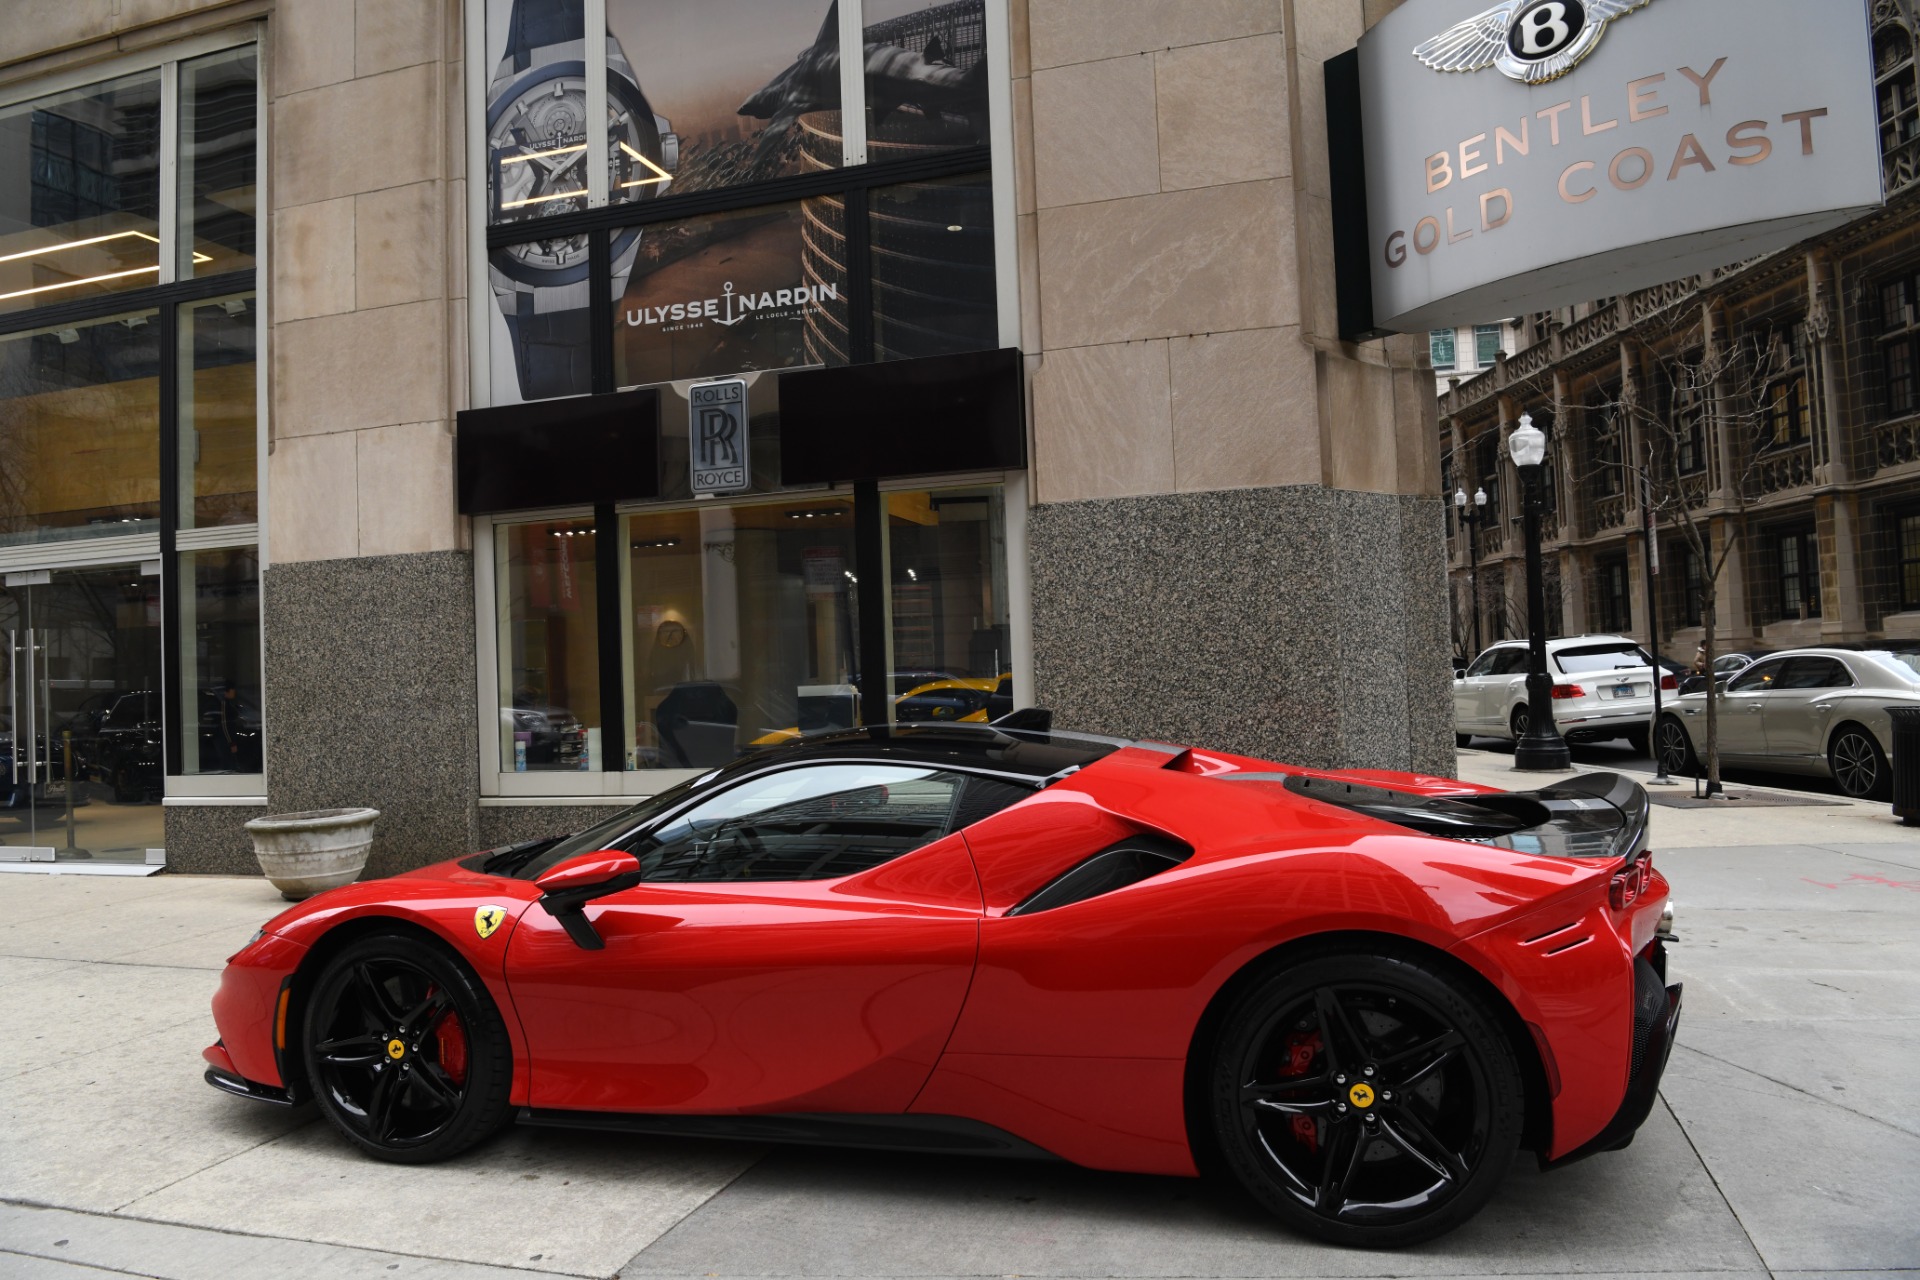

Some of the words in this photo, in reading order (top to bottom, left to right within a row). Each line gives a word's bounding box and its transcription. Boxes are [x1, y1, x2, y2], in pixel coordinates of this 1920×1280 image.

[1425, 57, 1727, 194] BENTLEY
[530, 140, 556, 150] ULYSSE
[563, 134, 586, 143] NARDI
[1384, 187, 1513, 268] GOLD
[1557, 107, 1828, 204] COAST
[626, 299, 719, 327] ULYSSE
[739, 283, 837, 312] NARDIN
[694, 387, 739, 403] ROLLS
[696, 471, 742, 486] ROYCE
